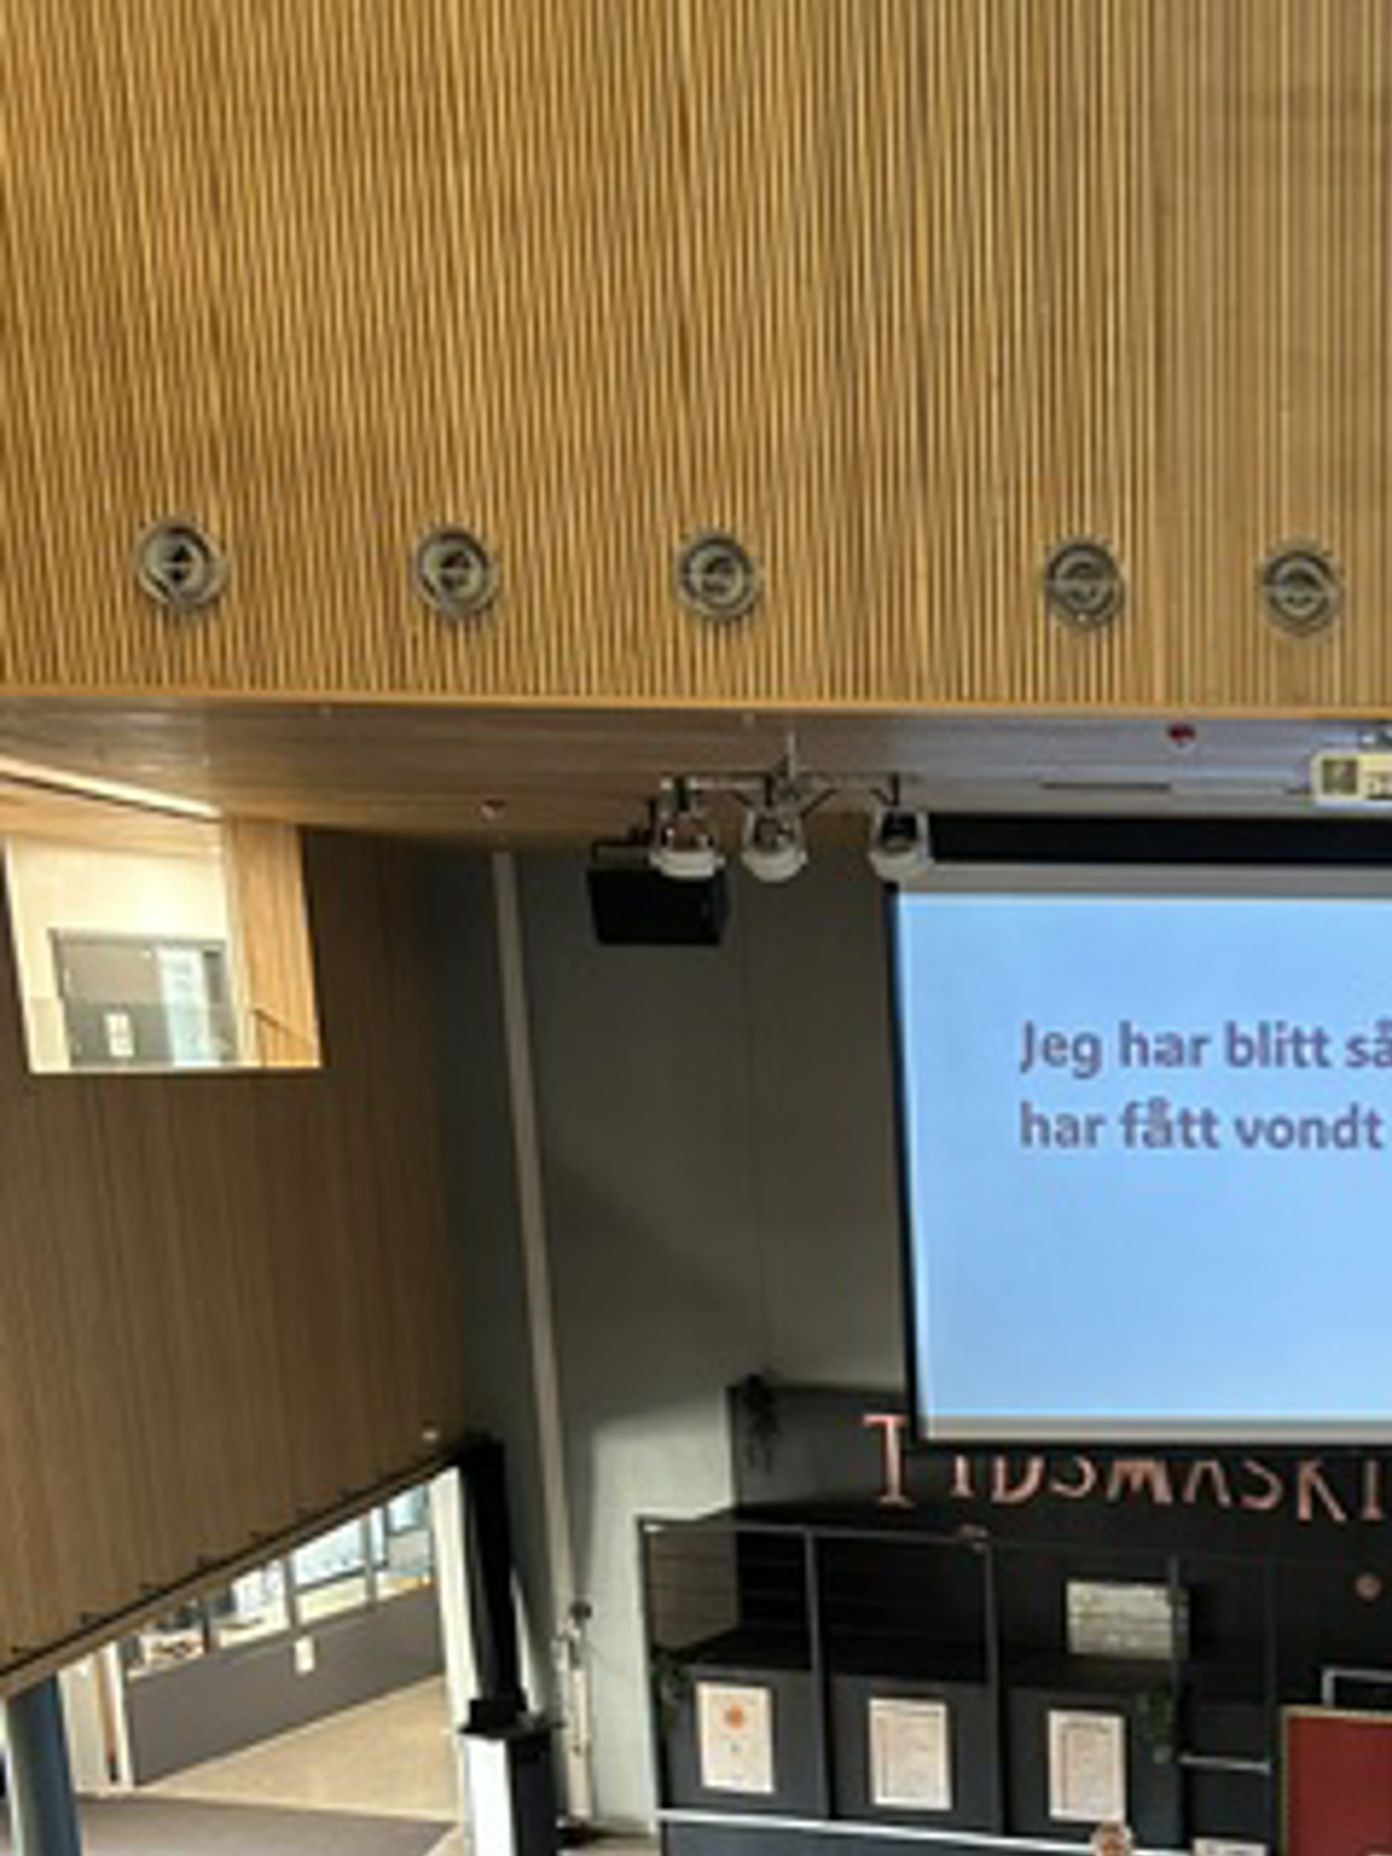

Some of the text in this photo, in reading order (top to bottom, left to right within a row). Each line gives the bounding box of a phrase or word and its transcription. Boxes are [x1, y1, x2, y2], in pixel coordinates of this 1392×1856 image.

[1020, 1020, 1101, 1079] Jeg
[1118, 1020, 1210, 1067] har
[1224, 1020, 1331, 1068] blitt
[1020, 1100, 1106, 1147] har
[1119, 1096, 1219, 1148] fått
[1234, 1102, 1382, 1149] vondt
